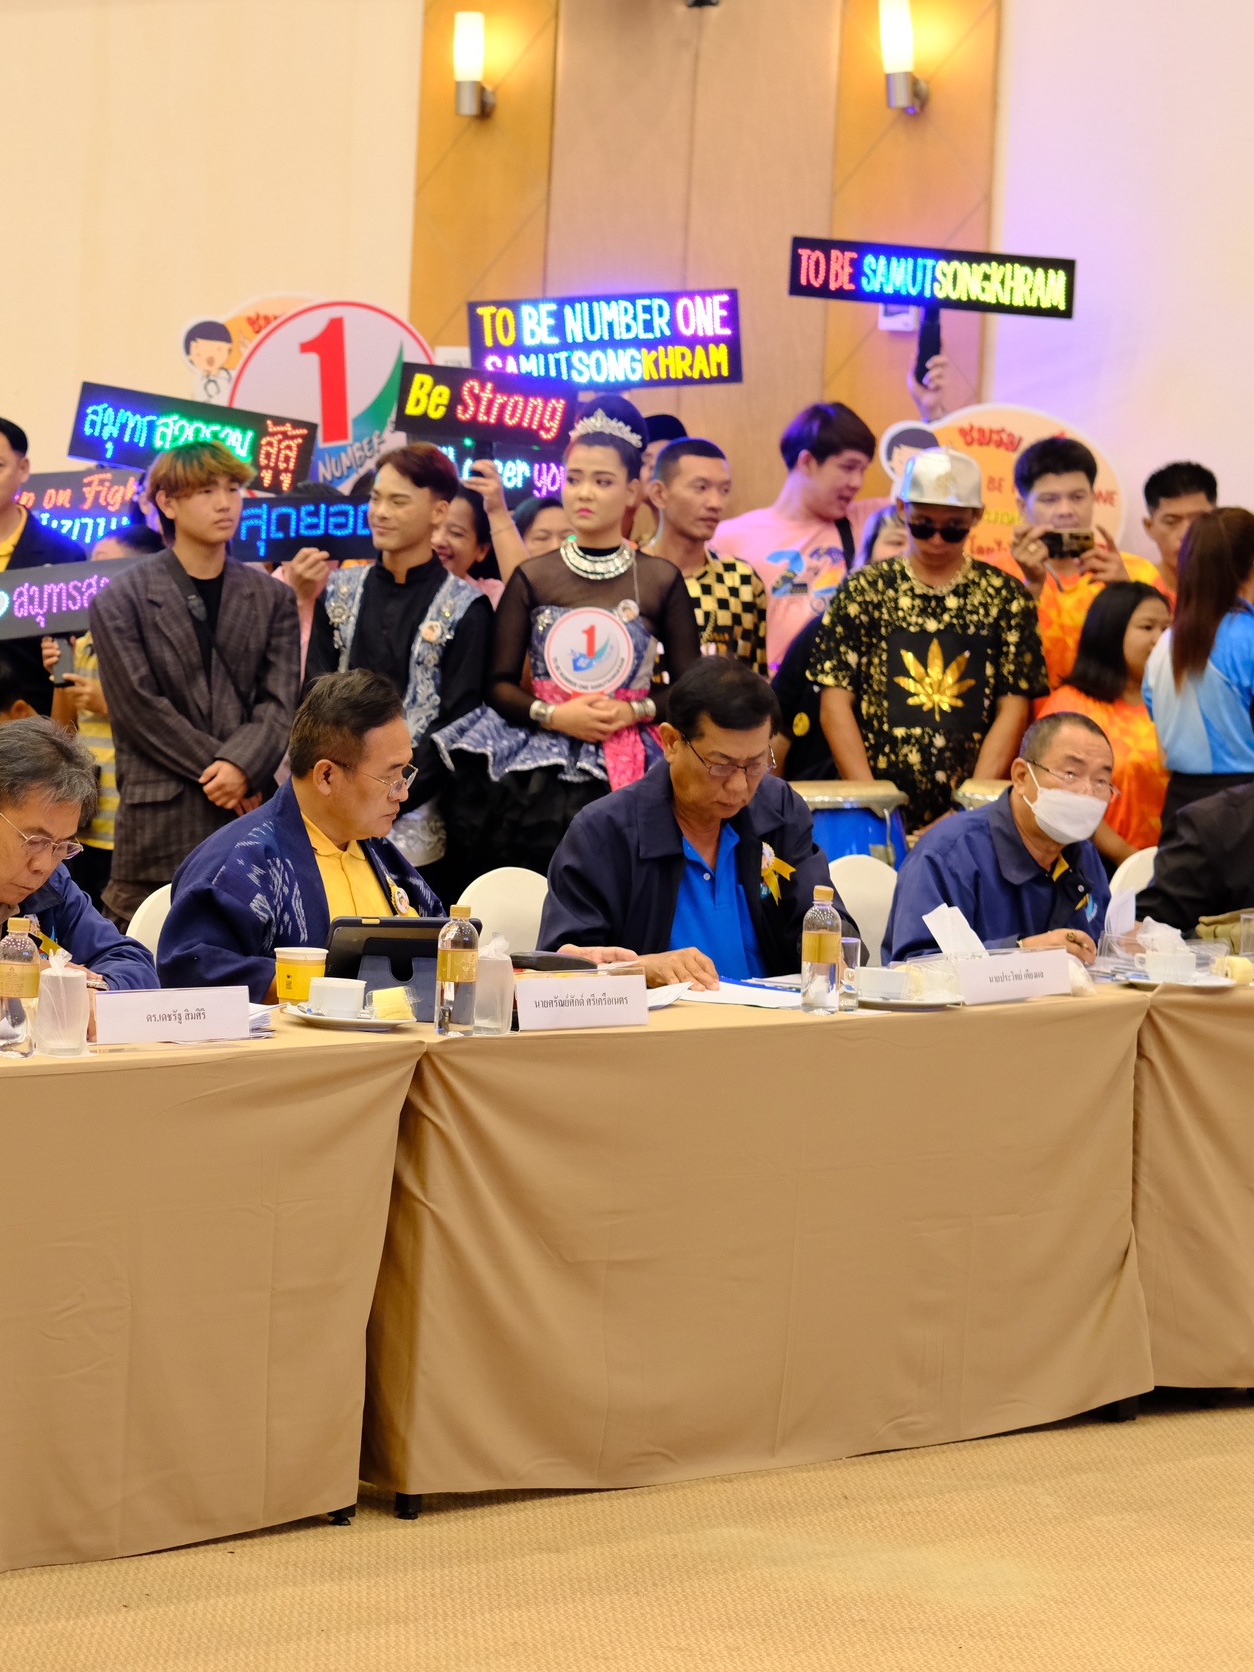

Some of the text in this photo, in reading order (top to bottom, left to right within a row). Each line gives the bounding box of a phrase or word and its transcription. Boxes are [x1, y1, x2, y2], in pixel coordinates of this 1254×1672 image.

[798, 249, 826, 288] TO
[829, 250, 858, 291] BE
[476, 294, 732, 347] TO BE NUMBER ONE
[300, 316, 348, 444] 1
[404, 372, 567, 441] Be Strong
[13, 574, 110, 628] สมุทรส
